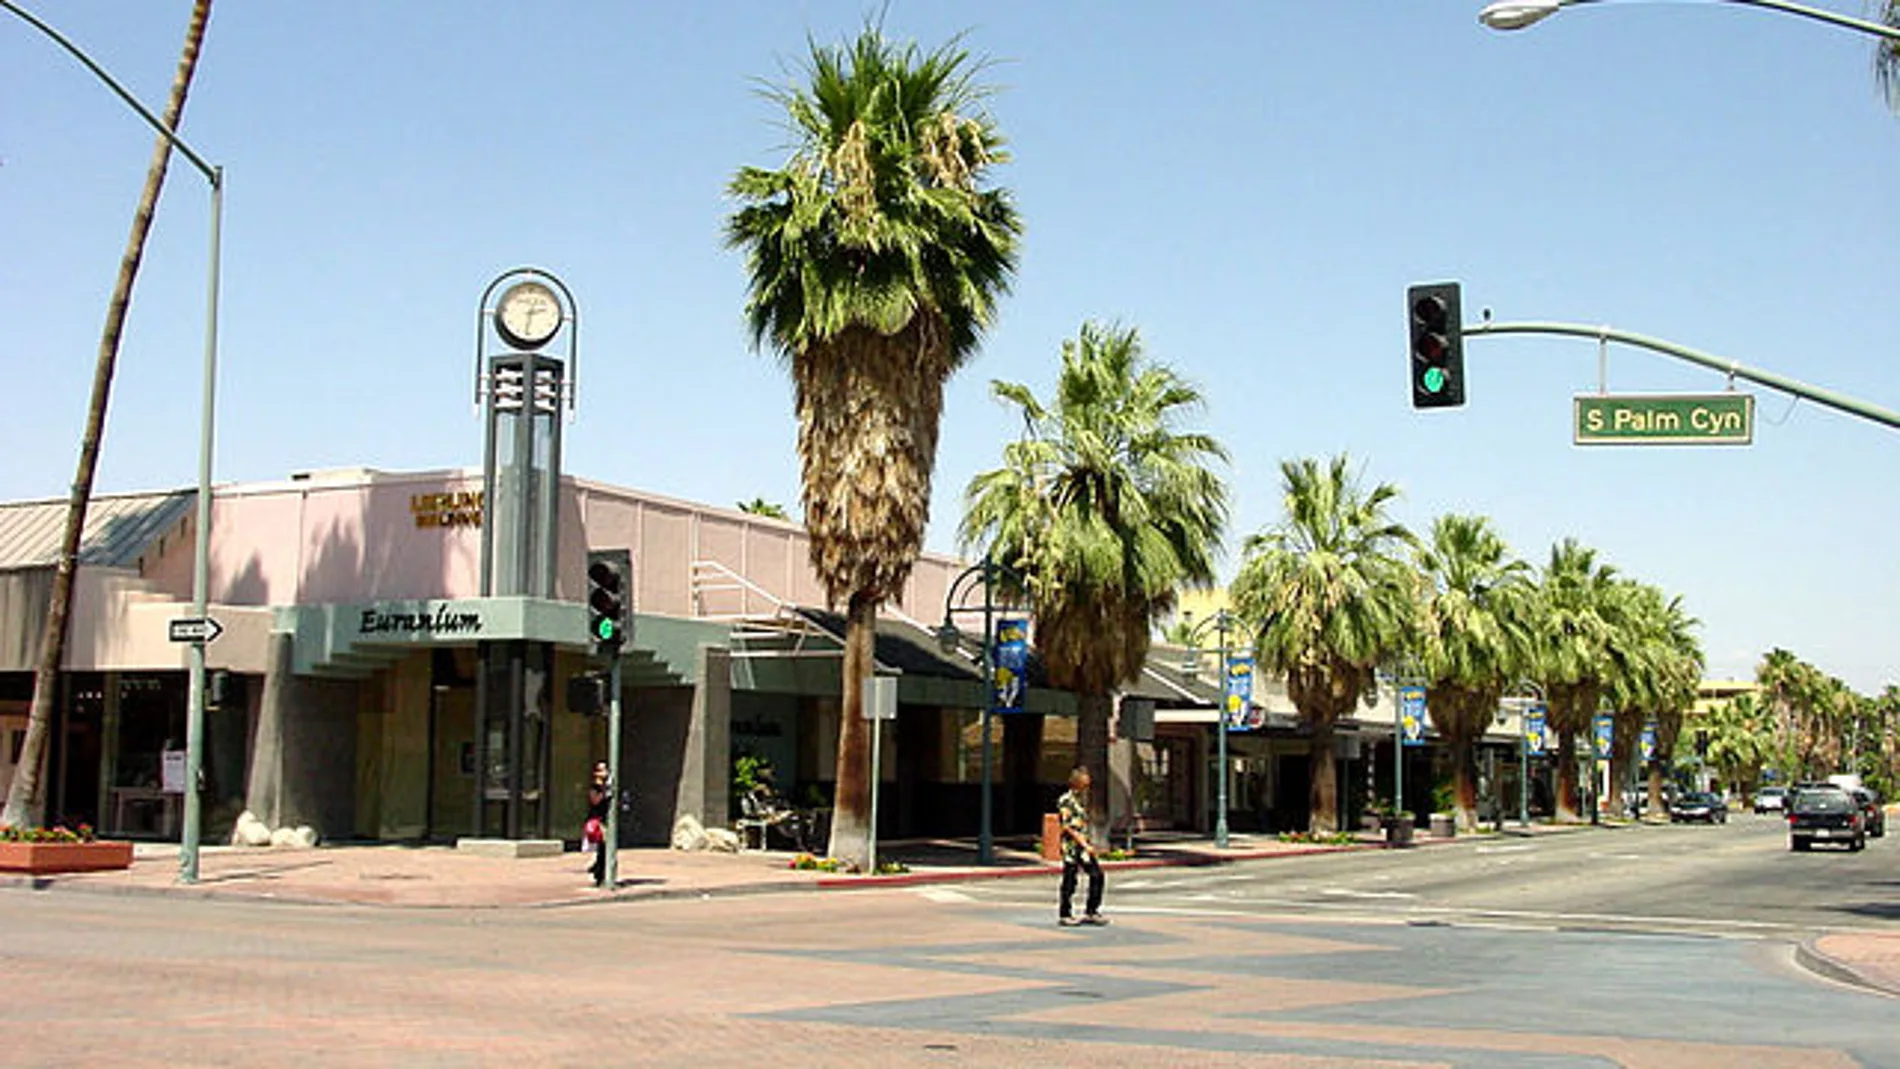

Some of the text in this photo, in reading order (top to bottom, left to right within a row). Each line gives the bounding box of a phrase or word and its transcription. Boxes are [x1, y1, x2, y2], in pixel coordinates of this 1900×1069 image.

[1587, 407, 1741, 434] S Palm Cyn
[359, 603, 482, 633] Euranium
